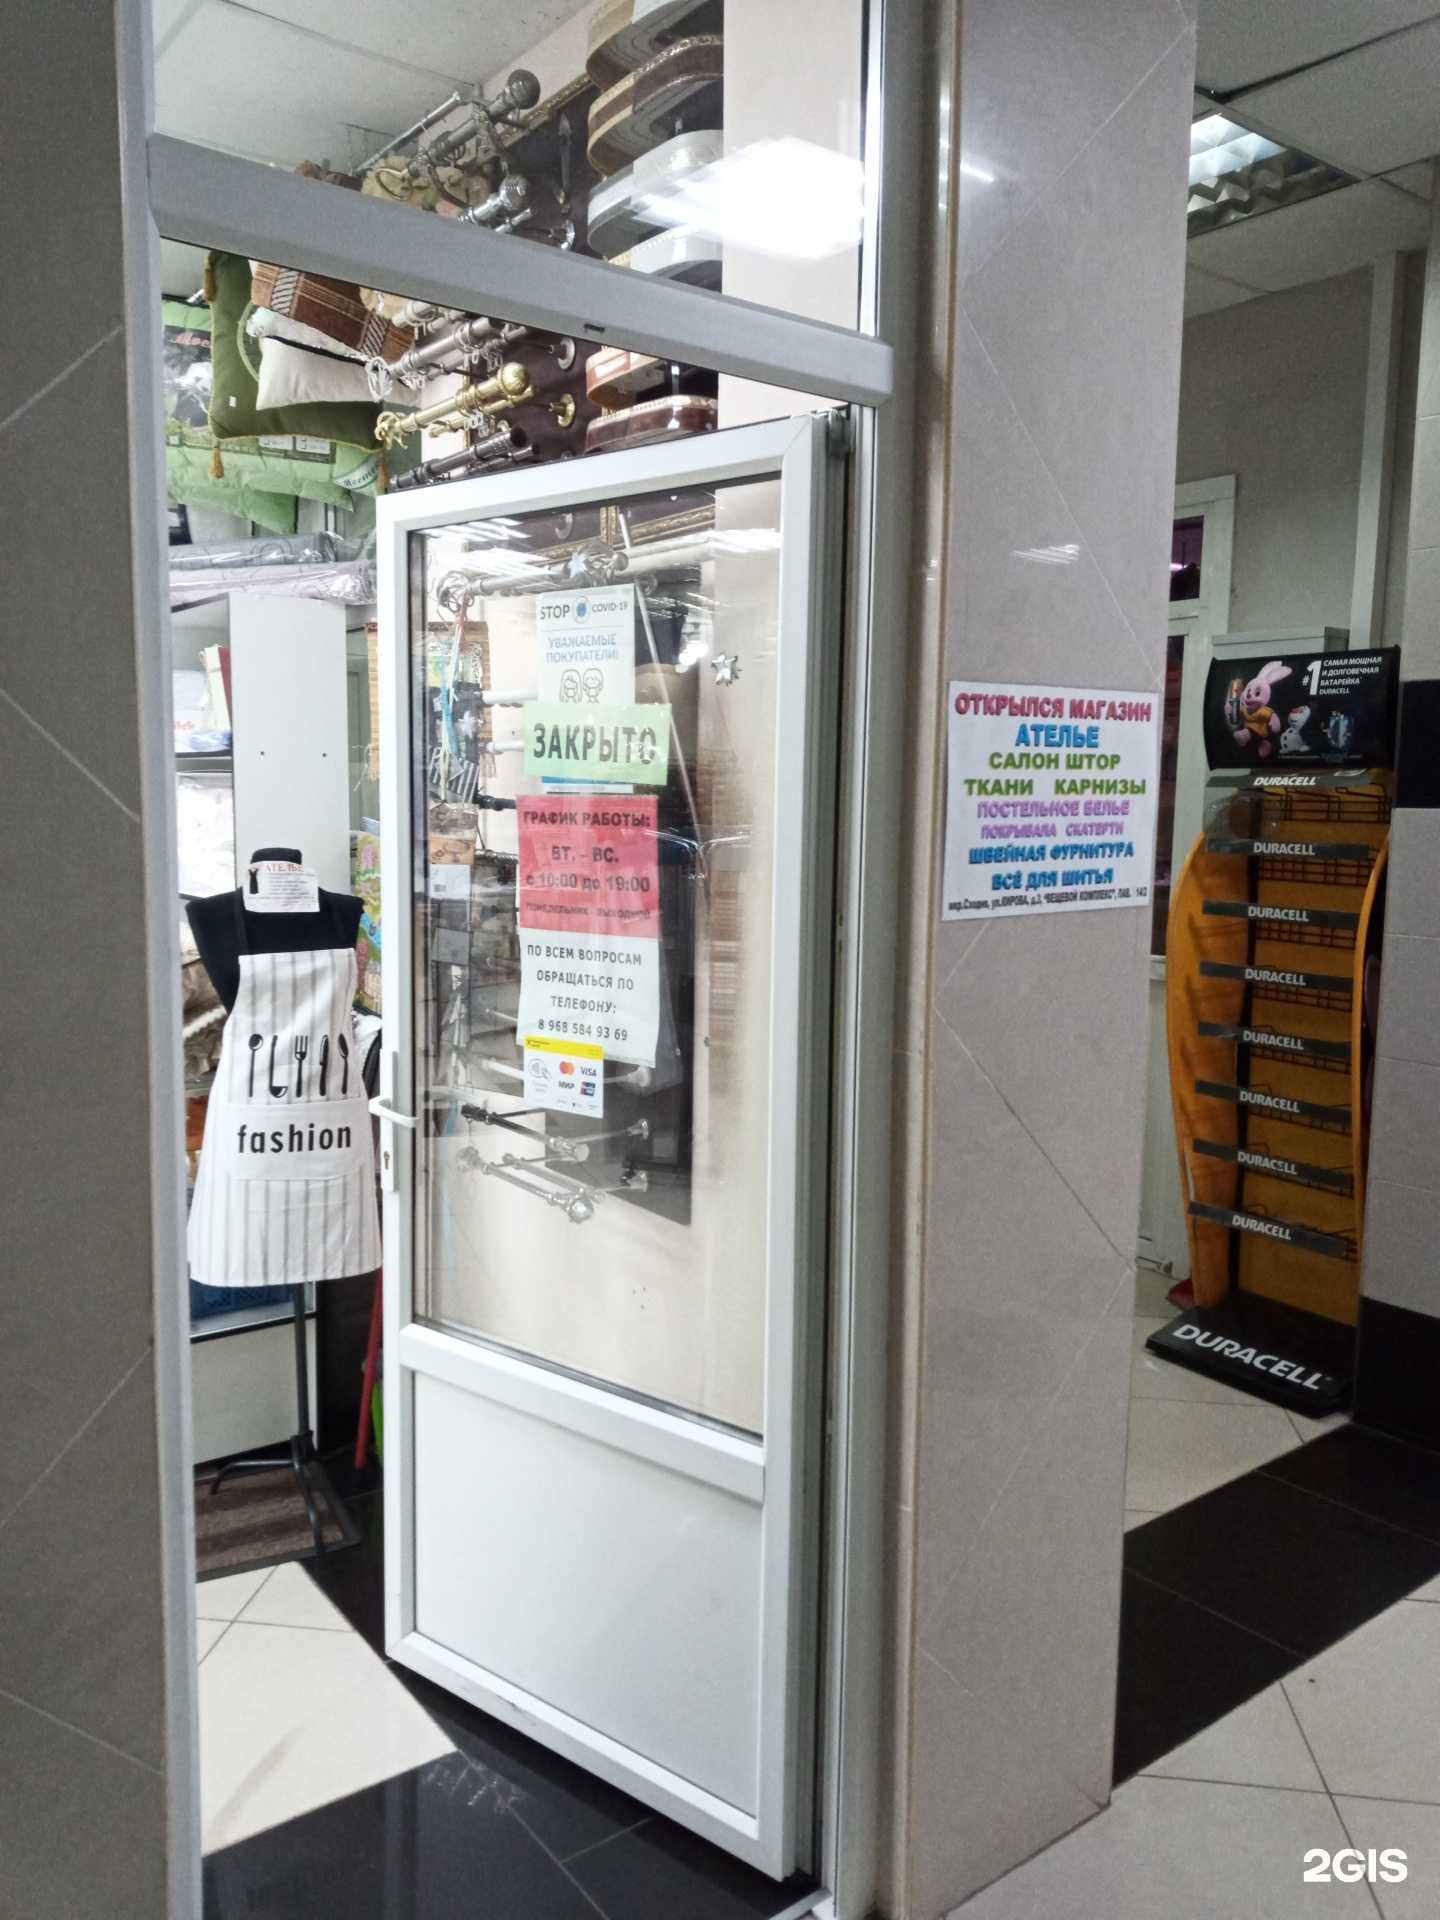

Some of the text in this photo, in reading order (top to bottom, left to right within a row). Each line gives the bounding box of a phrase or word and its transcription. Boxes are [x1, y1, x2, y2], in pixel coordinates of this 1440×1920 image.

[540, 601, 628, 620] STOP COVID-19
[548, 633, 617, 648] УВАЖАЕМЫЕ
[954, 693, 1151, 722] ОТКРЫЛСЯ МАГАЗИН
[533, 723, 657, 764] ЗАКРЫТО
[1015, 723, 1099, 748] АТЕЛЬЕ
[989, 752, 1121, 770] САЛОН ШТОР
[964, 779, 1146, 796] ТКАНИ КАРНИЗЫ
[1253, 776, 1317, 786] DURACELL
[977, 799, 1130, 818] ПОСТЕЛЬНОЕ БЕЛЬЕ
[523, 811, 650, 827] ГРАФИК РАБОТЫ:
[981, 821, 1124, 839] ПОКРЫВАЛА СКАТЕРТИ
[592, 847, 620, 862] ВС.
[968, 841, 1134, 864] ШВЕЙНАЯ ФУРНИТУРА
[1254, 842, 1315, 856] DURACELL
[540, 873, 577, 888] 10:00
[582, 876, 600, 890] до
[608, 876, 650, 892] 19:00
[992, 868, 1114, 892] ВСЁ ДЛЯ ШИТЬЯ
[1248, 906, 1309, 922] DURACELL
[527, 944, 642, 965] ПО ВСЕМ ВОПРОСАМ
[536, 970, 635, 990] ОБРАЩАТЬСЯ ПО
[1245, 968, 1306, 986] DURACELL
[551, 995, 617, 1014] ТЕЛЕФОНУ:
[538, 1018, 544, 1030] 8
[596, 1025, 610, 1038] 93
[614, 1028, 628, 1040] 69
[1243, 1030, 1304, 1050] DURACELL
[580, 1066, 597, 1077] VISA
[1240, 1090, 1300, 1113] DURACELL
[238, 1123, 351, 1154] fashion
[1237, 1151, 1297, 1175] DURACELL
[1232, 1214, 1291, 1240] DURACELL
[1172, 1324, 1323, 1390] DURACELL
